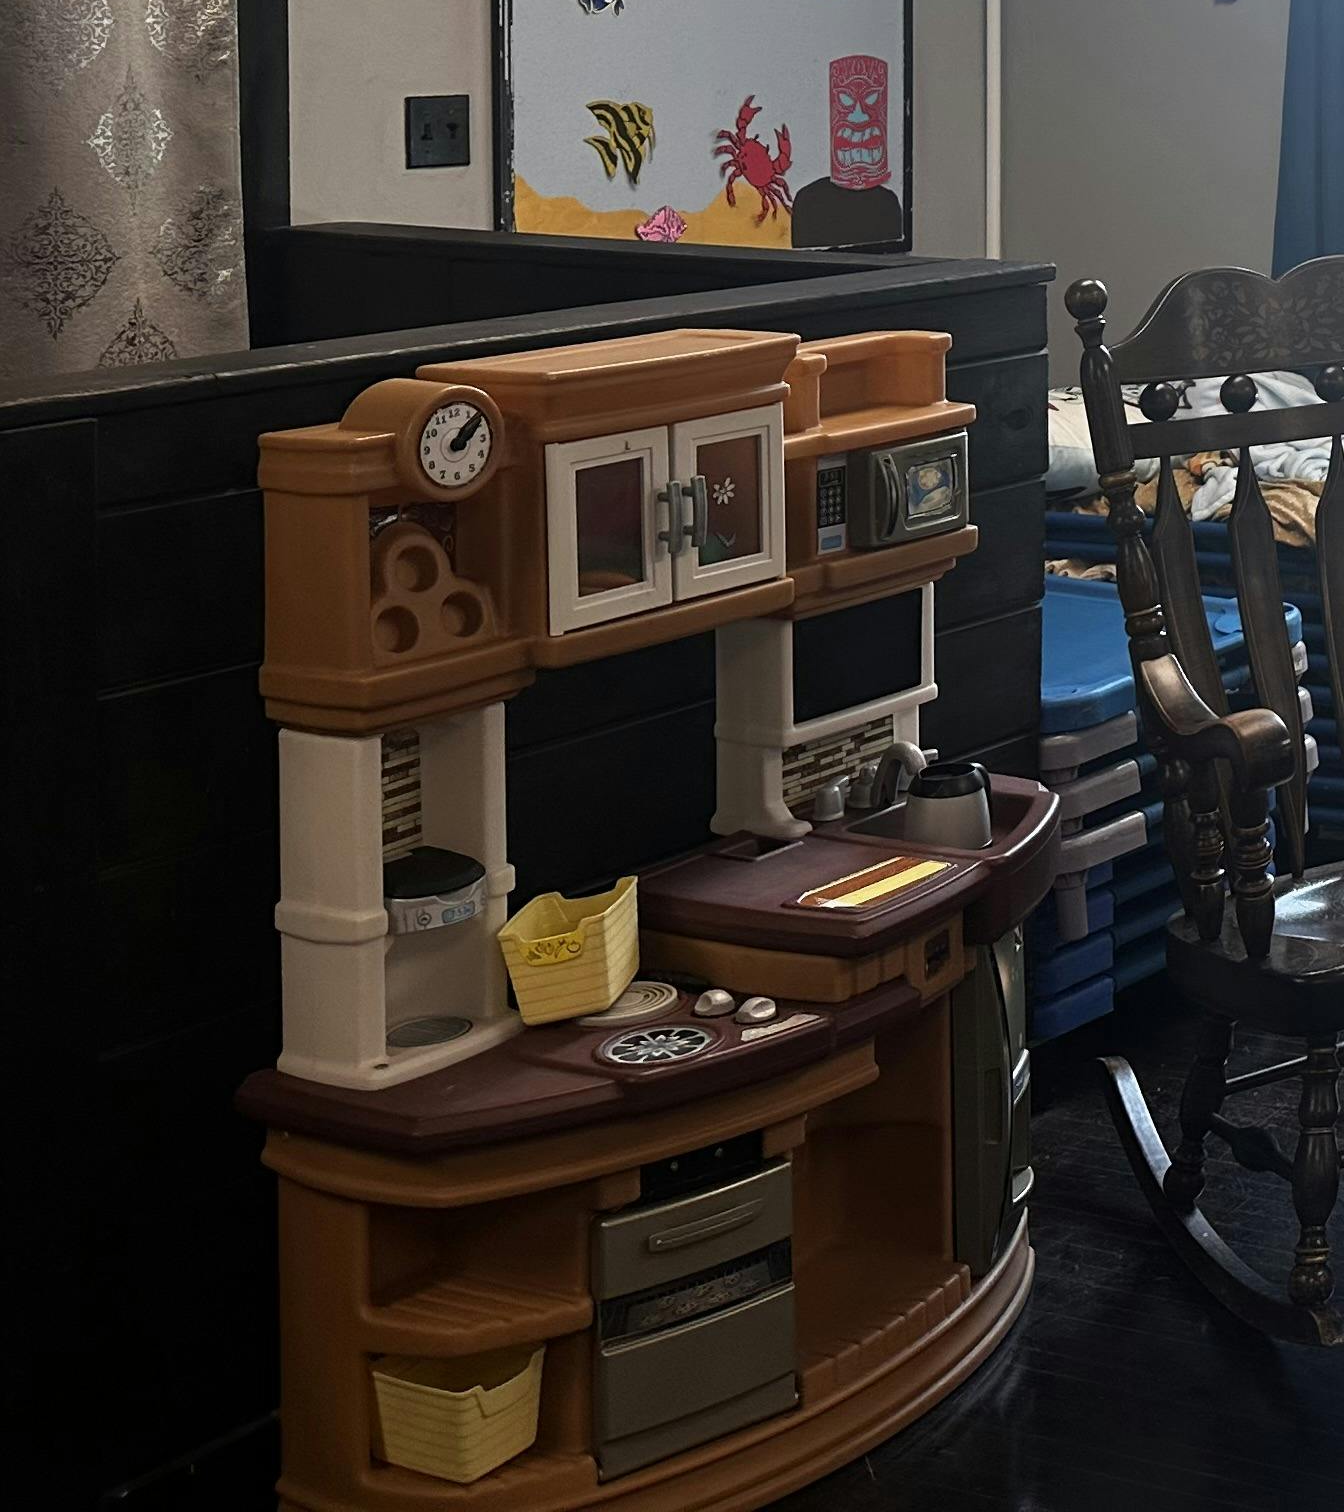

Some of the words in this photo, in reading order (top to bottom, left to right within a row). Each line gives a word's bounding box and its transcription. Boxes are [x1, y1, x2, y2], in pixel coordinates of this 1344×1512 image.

[448, 408, 460, 419] 12
[435, 415, 447, 425] 11
[425, 428, 438, 439] 10
